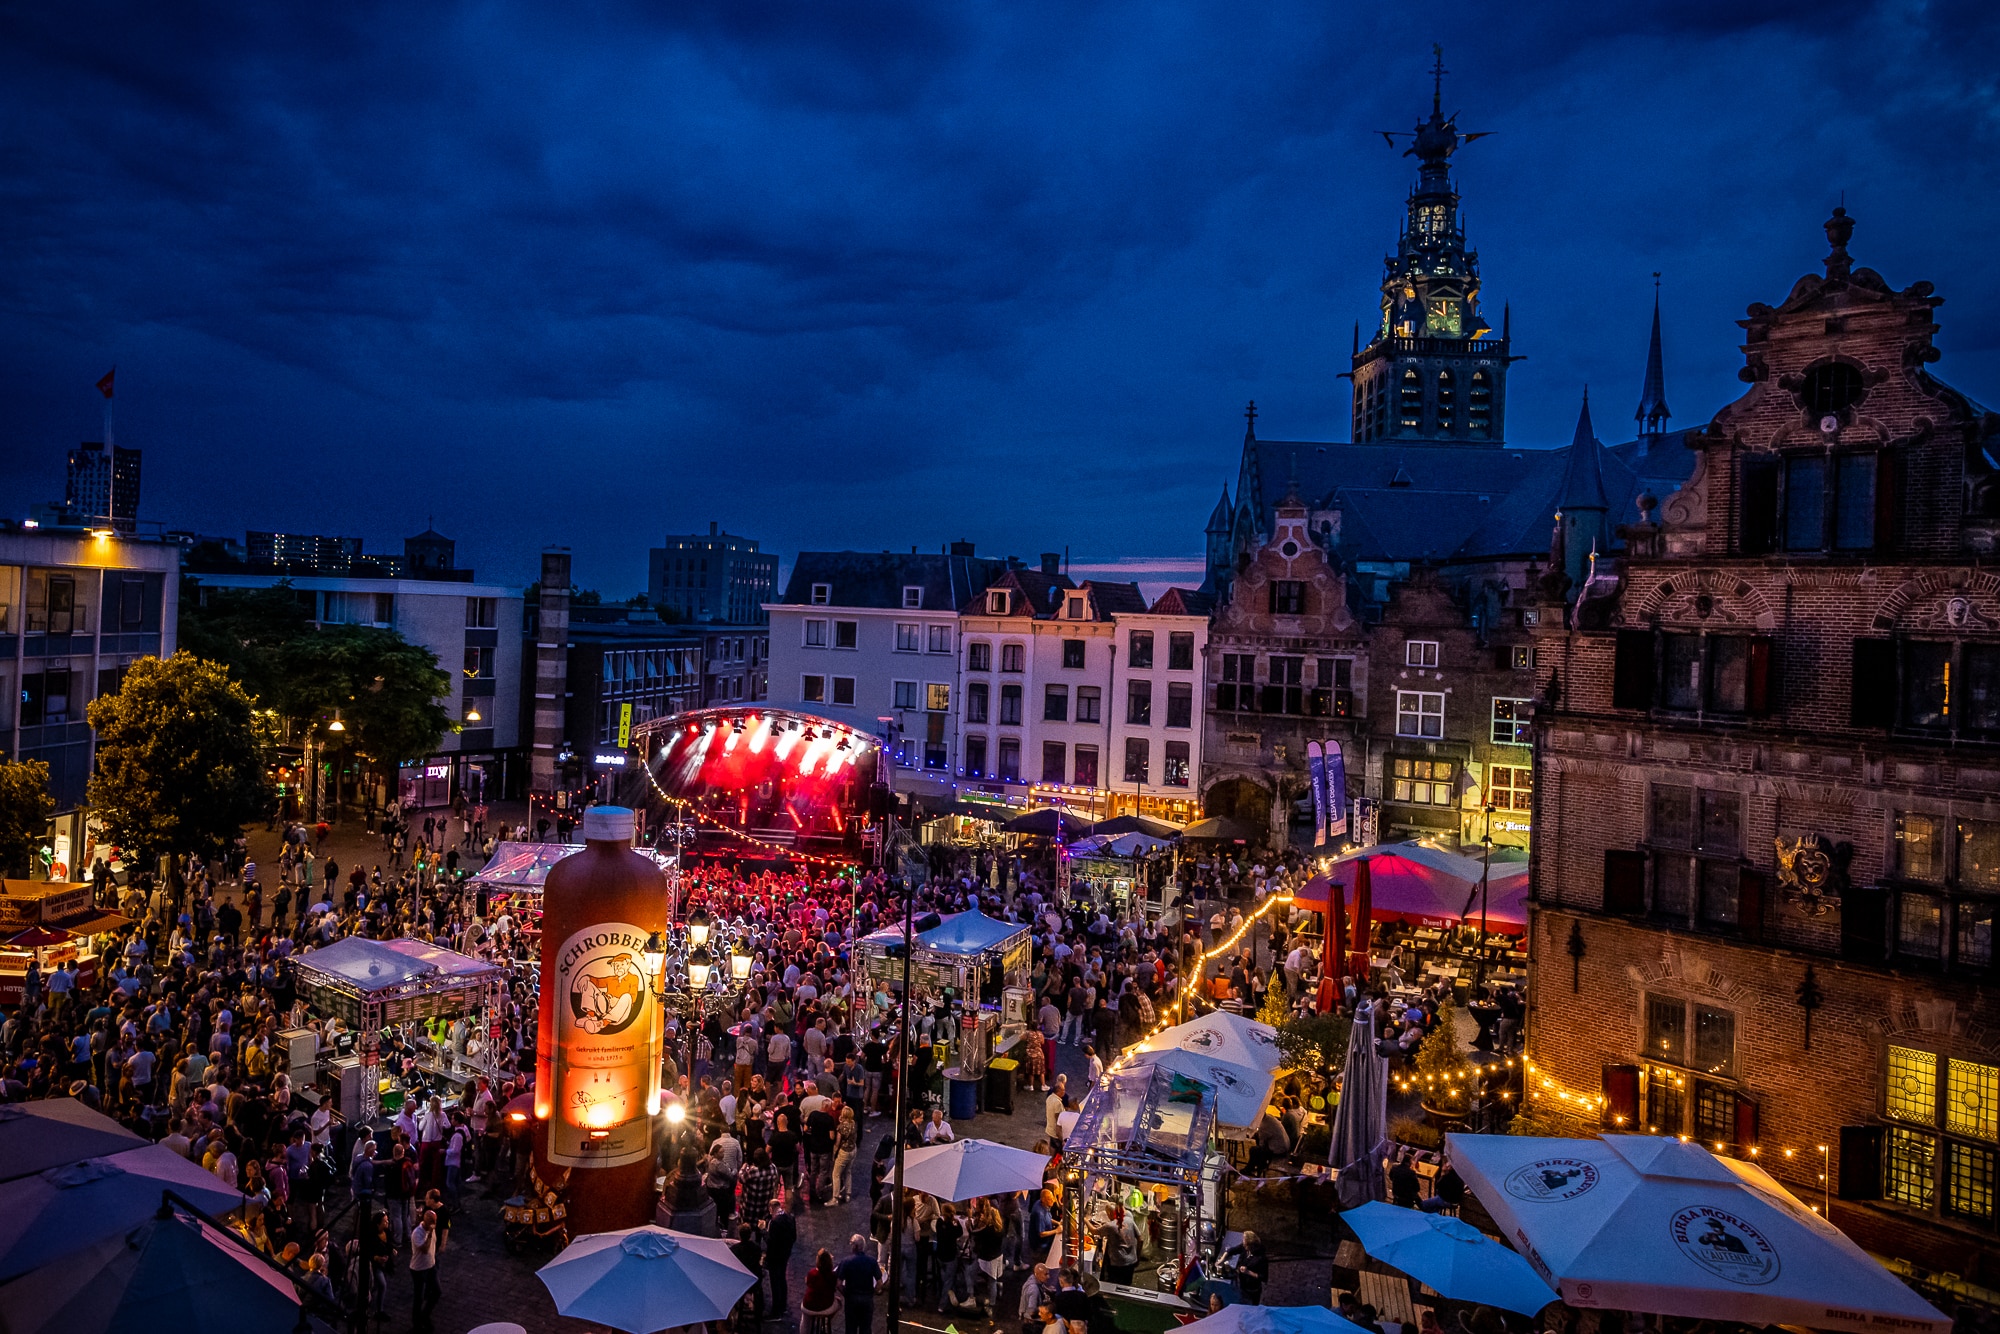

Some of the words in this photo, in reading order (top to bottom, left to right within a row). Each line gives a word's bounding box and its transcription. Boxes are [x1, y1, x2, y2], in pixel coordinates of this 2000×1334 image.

[621, 711, 629, 745] EXIT
[45, 888, 91, 907] HAMBURGERS
[52, 903, 65, 915] HOT
[67, 899, 84, 911] DOGS
[560, 933, 646, 976] SCHROBBEL
[1535, 1160, 1583, 1169] BIRRA
[1562, 1163, 1596, 1199] MORETTI
[1675, 1210, 1701, 1244] BIRRA
[1700, 1207, 1772, 1253] MORETTI
[1700, 1250, 1764, 1266] L'AUTENTICA
[1825, 1309, 1866, 1322] BIRRA
[1872, 1315, 1933, 1331] MORETTI
